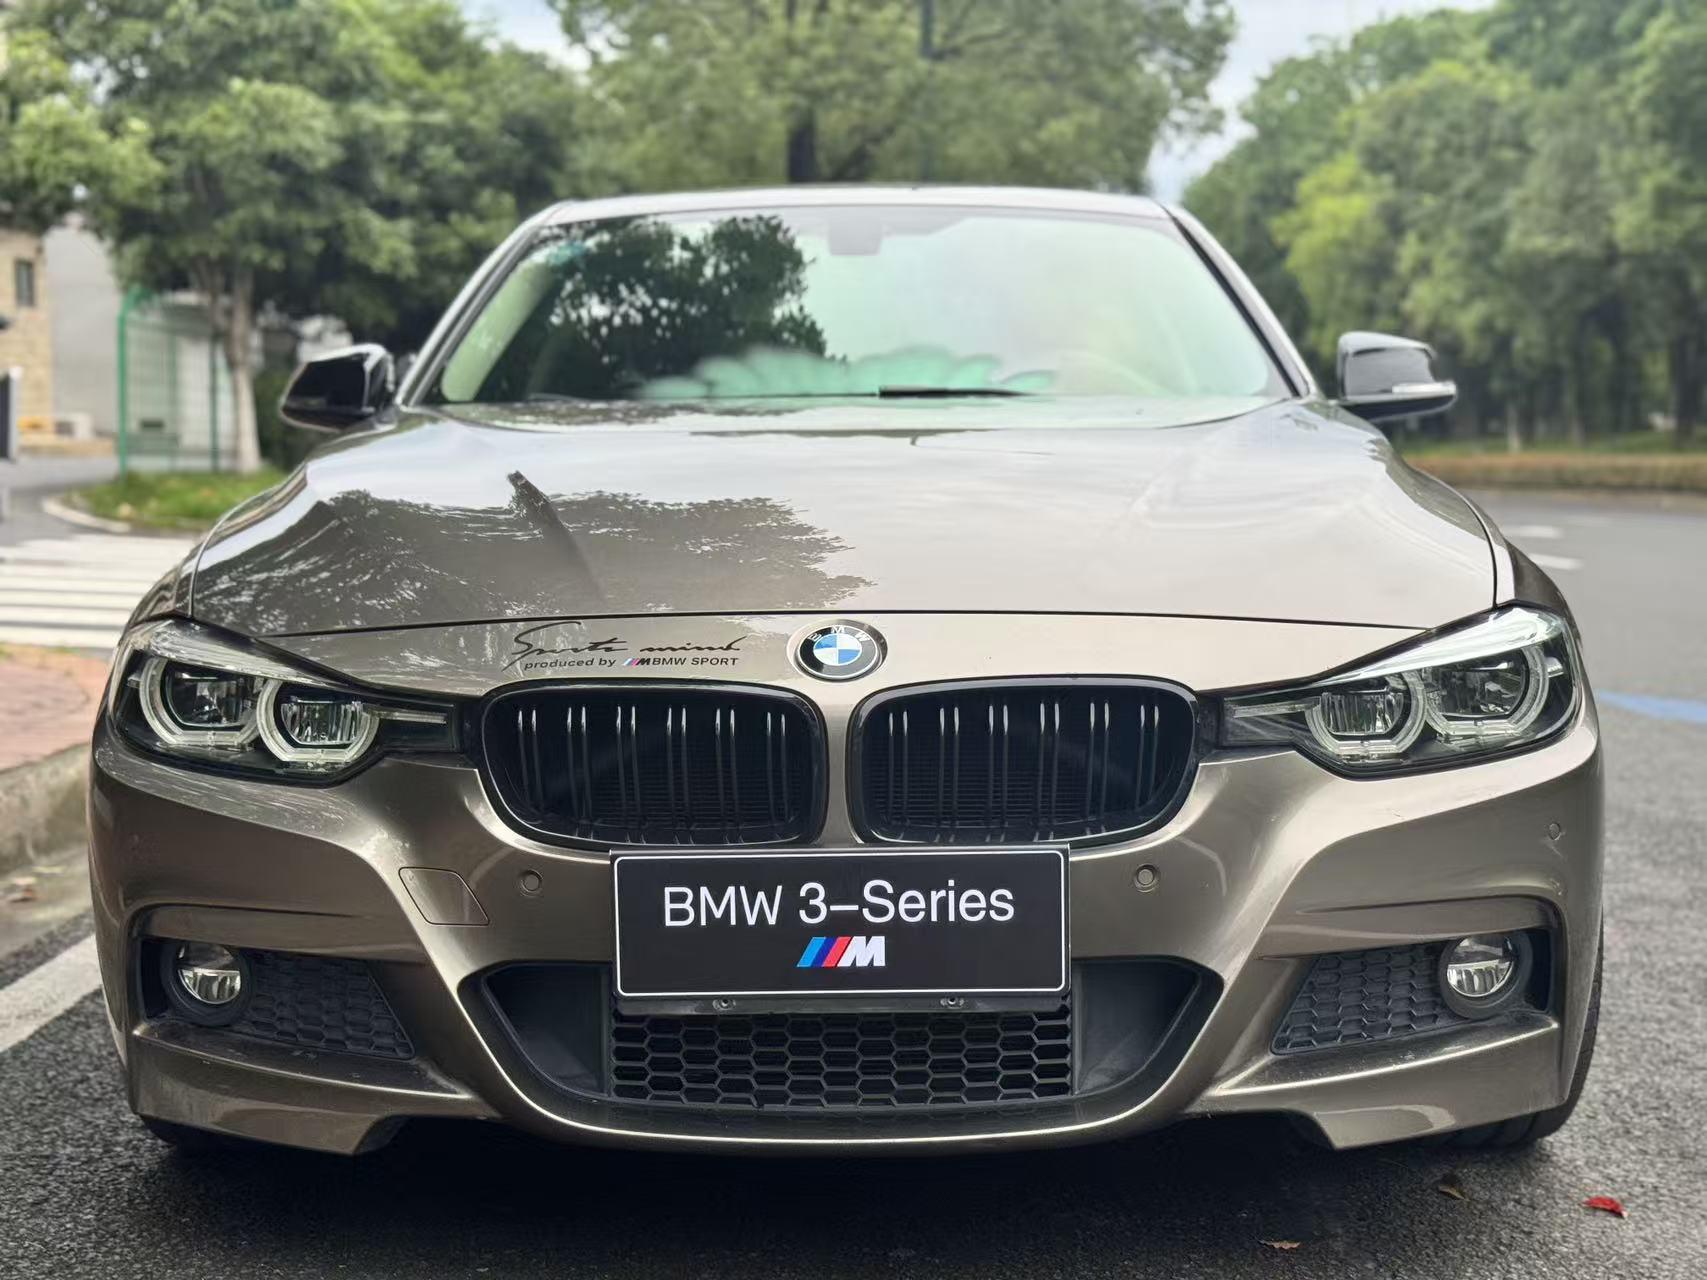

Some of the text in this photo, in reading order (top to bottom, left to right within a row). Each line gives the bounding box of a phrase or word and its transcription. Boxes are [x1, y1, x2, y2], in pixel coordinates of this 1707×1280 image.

[806, 625, 871, 642] BMW
[524, 658, 595, 670] produced
[598, 657, 617, 668] by
[691, 657, 739, 666] SPORT
[664, 879, 1016, 927] BMW 3-Series
